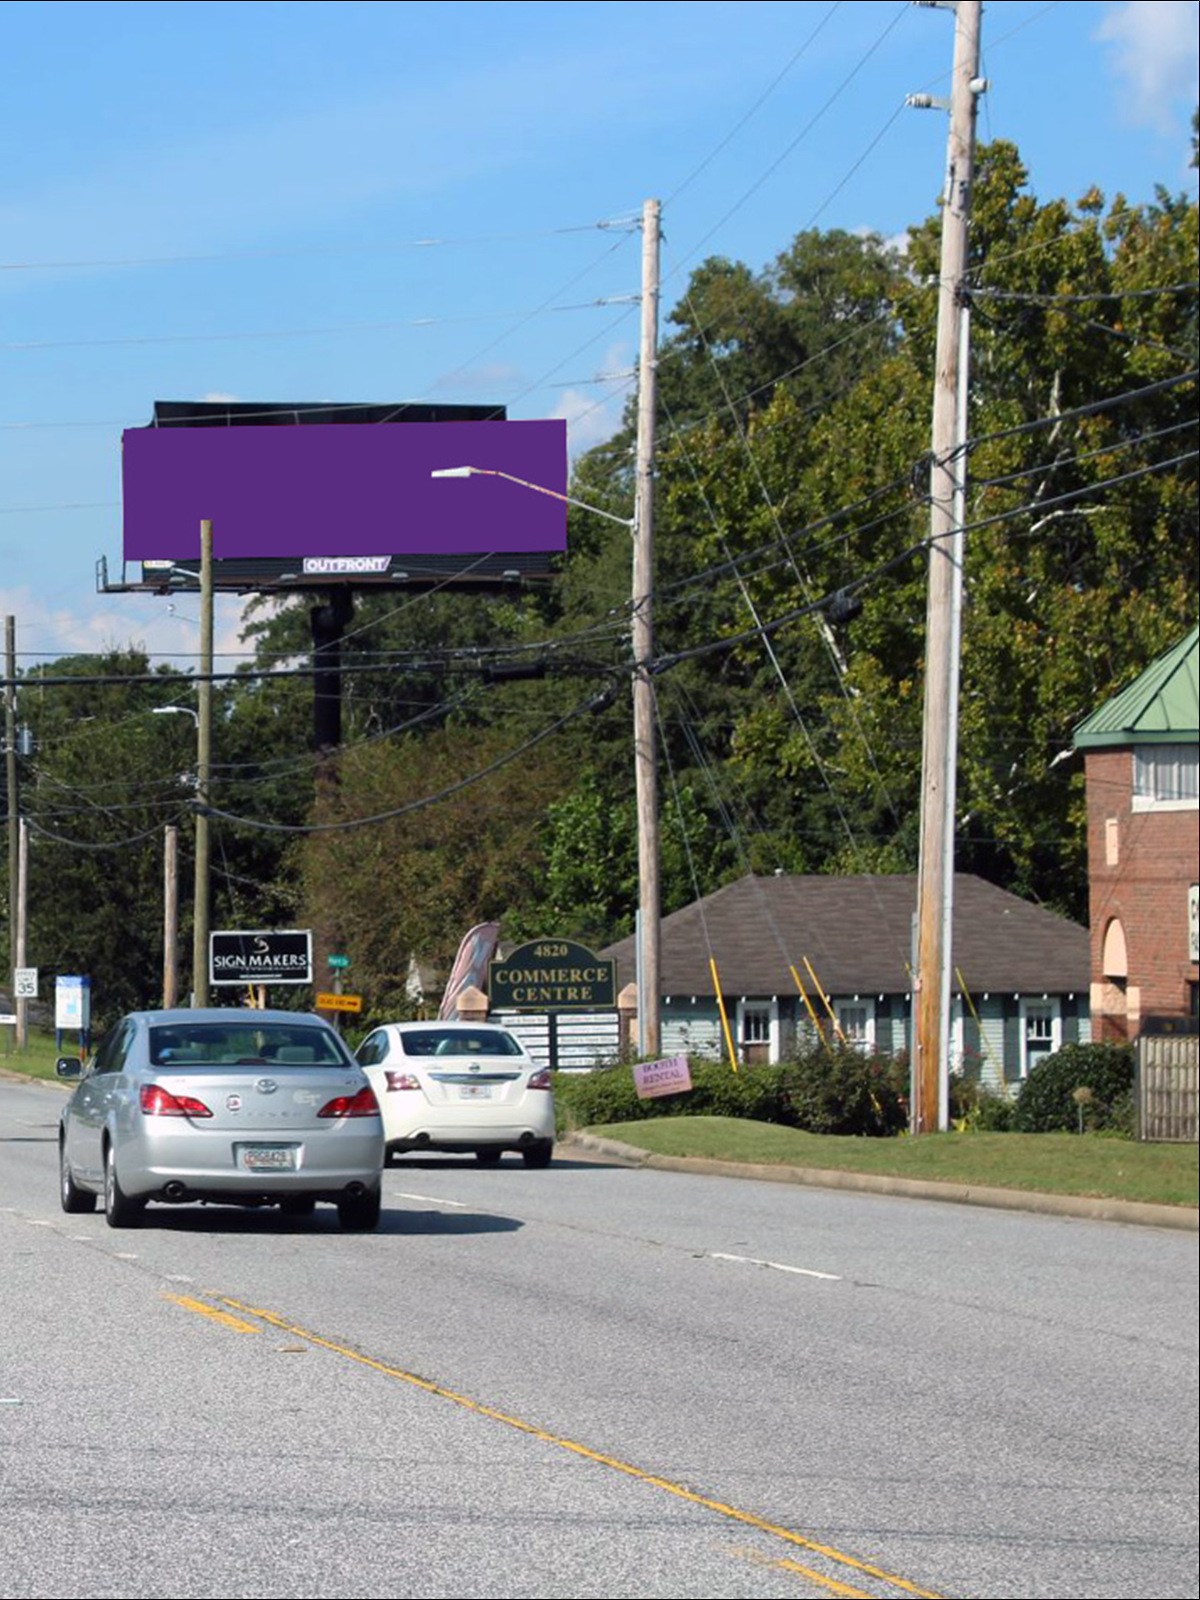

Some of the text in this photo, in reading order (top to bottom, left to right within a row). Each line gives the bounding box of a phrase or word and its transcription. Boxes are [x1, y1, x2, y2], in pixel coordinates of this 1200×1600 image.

[306, 558, 387, 572] OUTFRONT
[534, 944, 568, 957] 4820
[214, 954, 307, 968] SIGN MAKERS
[495, 968, 609, 985] COMMERCE
[17, 982, 35, 995] 35
[512, 986, 592, 1002] CENTRE
[642, 1069, 684, 1085] RENTAL
